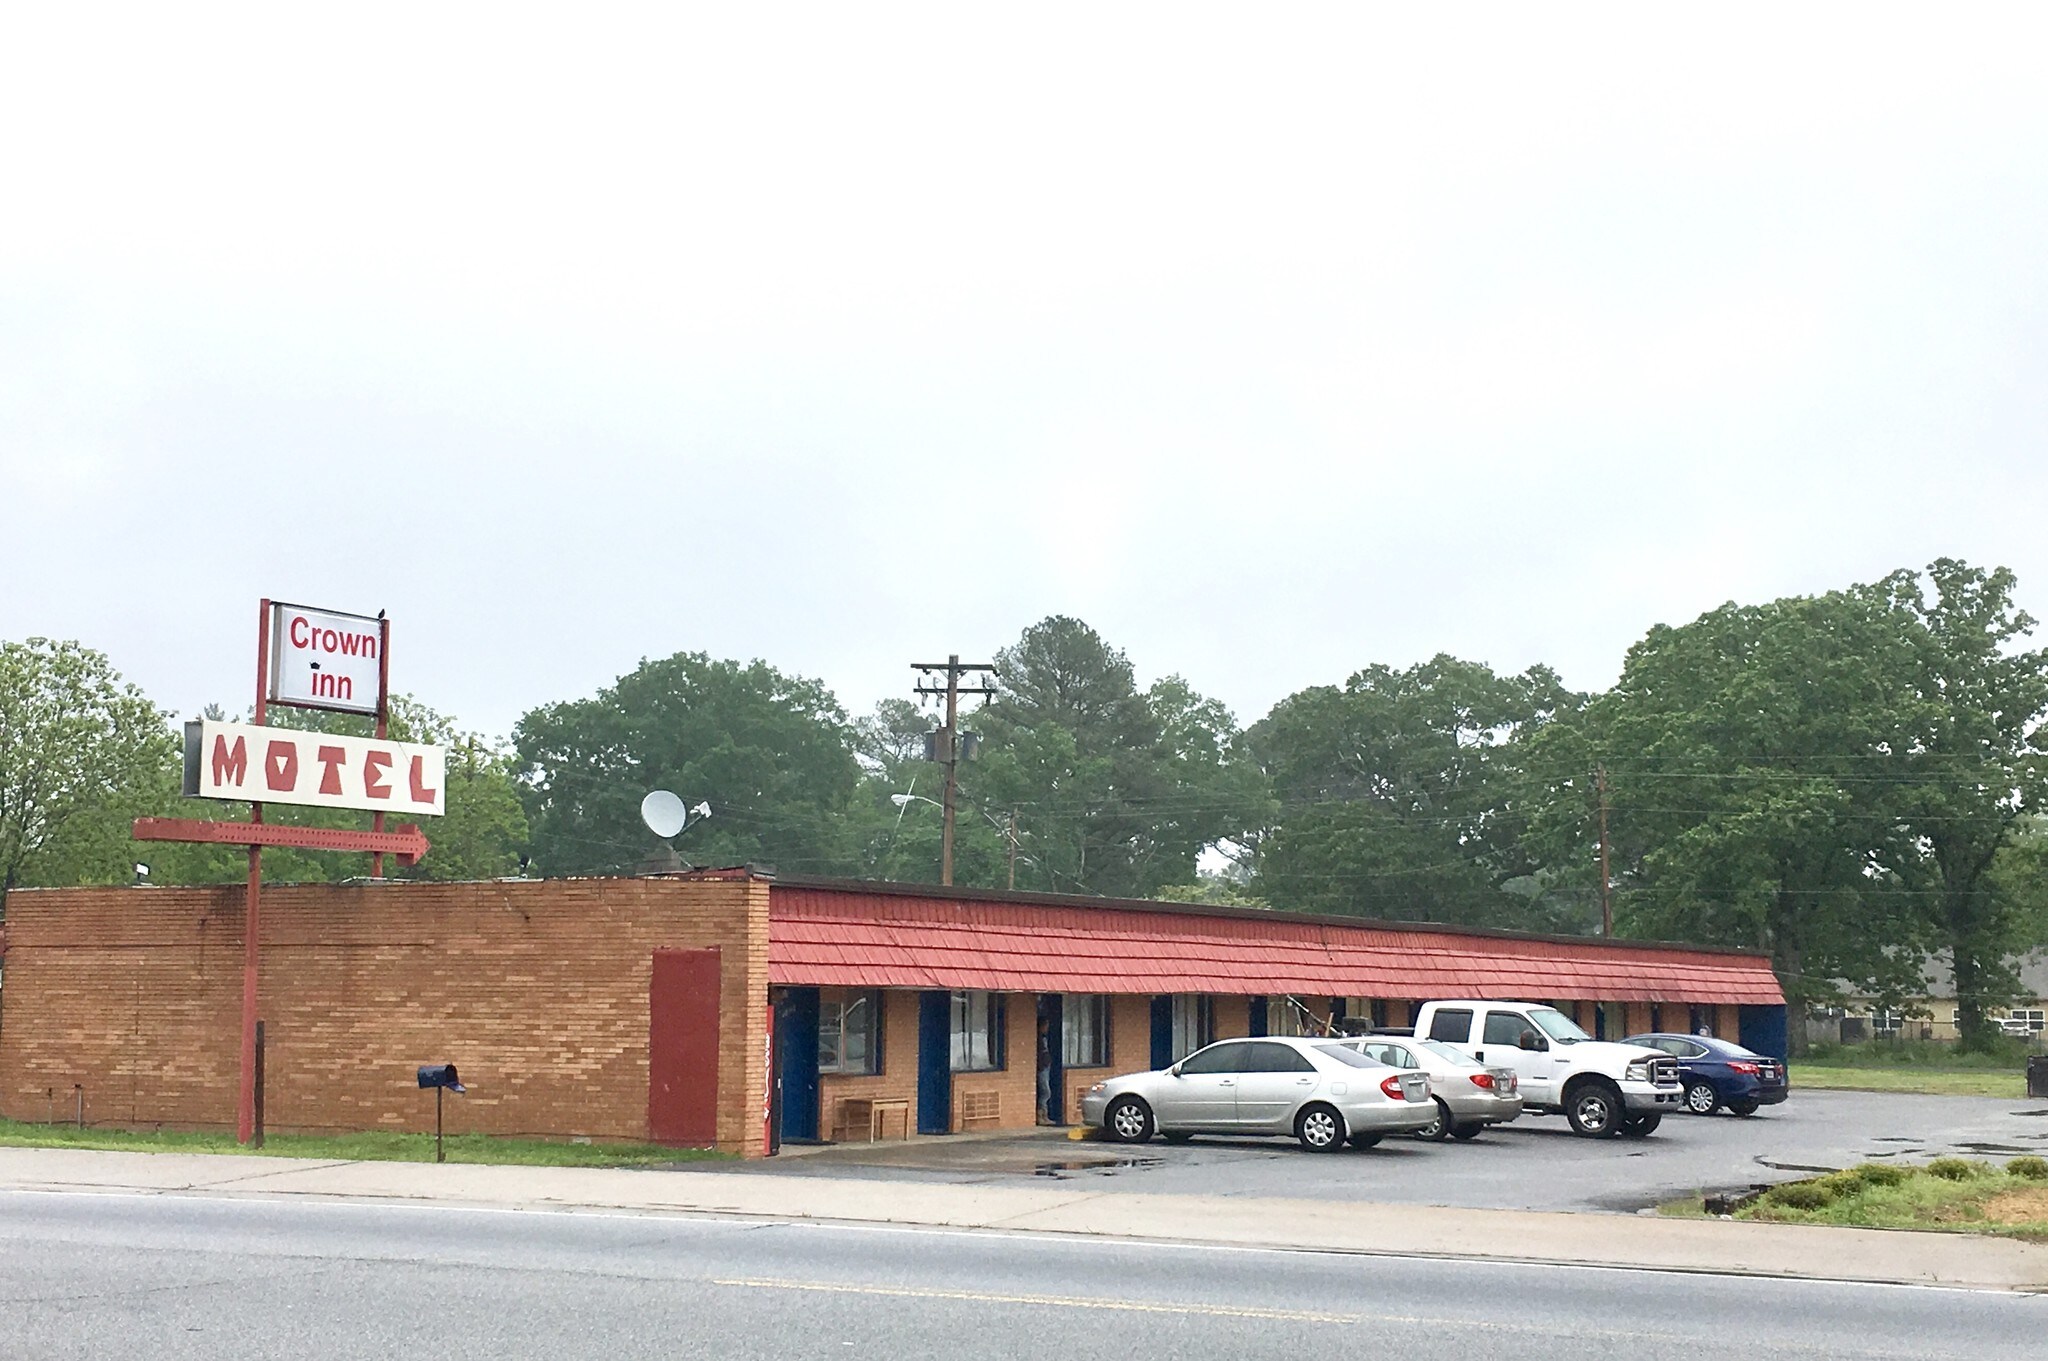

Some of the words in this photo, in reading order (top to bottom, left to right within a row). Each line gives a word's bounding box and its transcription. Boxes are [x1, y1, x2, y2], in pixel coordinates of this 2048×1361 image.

[290, 616, 376, 659] Crown
[312, 672, 352, 700] inn
[212, 734, 436, 804] MOTEL
